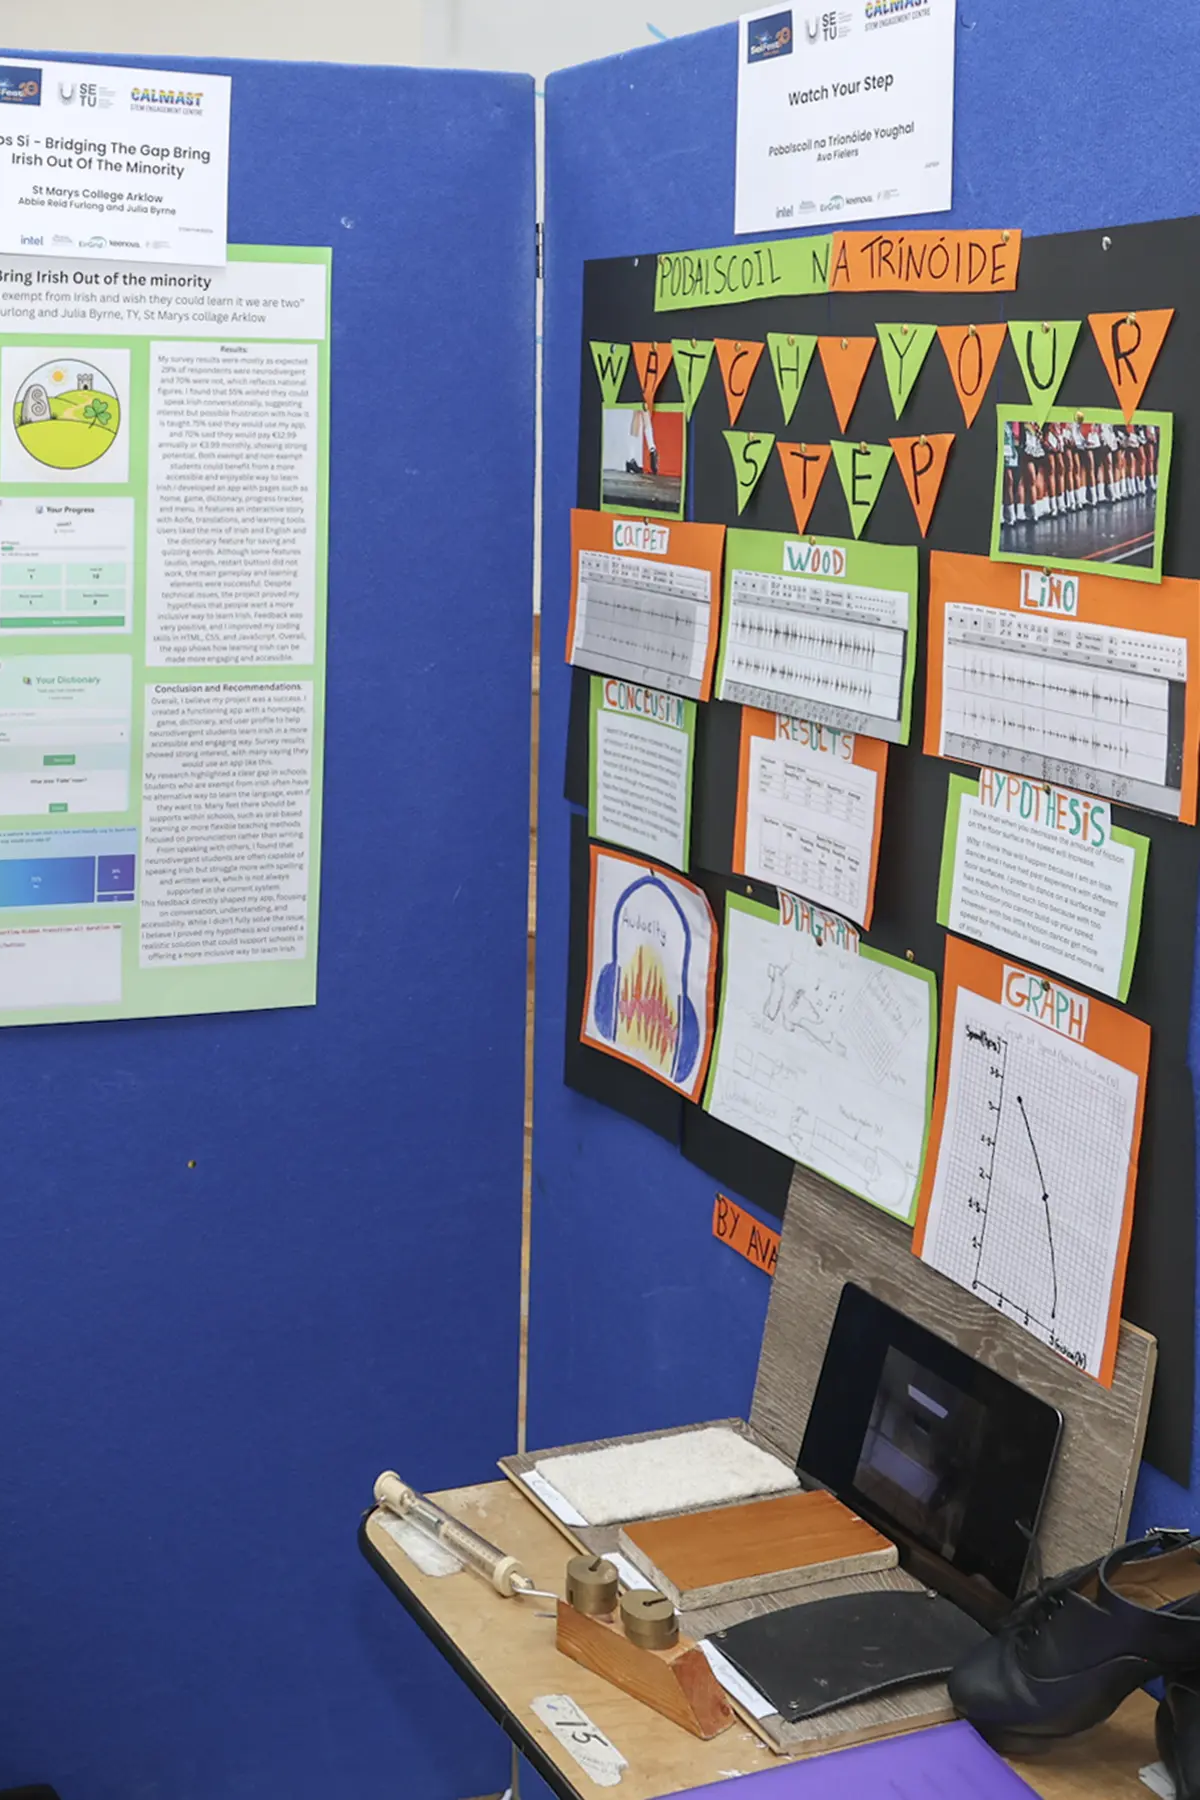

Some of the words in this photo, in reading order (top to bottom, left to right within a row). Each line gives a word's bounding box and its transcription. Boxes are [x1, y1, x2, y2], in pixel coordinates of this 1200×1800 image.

[865, 0, 928, 18] CALMA
[822, 11, 837, 27] SE
[823, 27, 837, 42] TU
[79, 83, 97, 95] SE
[130, 86, 205, 108] CALMAST
[788, 85, 828, 105] Watch
[832, 81, 860, 96] Your
[864, 74, 893, 91] Step
[80, 95, 98, 108] TU
[768, 139, 812, 156] Pobalscoil
[814, 139, 826, 148] na
[874, 121, 914, 140] Youghal
[45, 137, 106, 156] Bridging
[110, 142, 136, 155] The
[140, 144, 170, 160] Gap
[173, 146, 210, 163] Bring
[816, 152, 832, 161] Ava
[12, 152, 42, 166] Irish
[46, 155, 72, 168] Out
[76, 157, 92, 169] Of
[96, 158, 122, 171] The
[126, 160, 184, 179] Minority
[32, 185, 42, 194] St
[46, 186, 79, 199] Marys
[82, 189, 124, 202] College
[126, 192, 162, 202] Arklow
[18, 197, 45, 206] Abbie
[47, 198, 67, 208] Reid
[69, 198, 104, 212] Furlong
[106, 201, 124, 212] and
[126, 205, 148, 213] Julia
[150, 205, 176, 215] Byrne
[20, 234, 44, 246] intel
[659, 248, 781, 298] POBALSCOIL
[812, 240, 850, 285] NA
[36, 270, 68, 283] Irish
[72, 271, 99, 284] Out
[103, 272, 119, 284] of
[122, 272, 146, 286] the
[150, 273, 211, 291] minority
[1, 292, 42, 302] exempt
[45, 290, 71, 302] from
[74, 292, 96, 302] Irish
[99, 293, 119, 303] and
[122, 293, 146, 303] wish
[148, 294, 172, 307] they
[174, 295, 204, 305] could
[206, 296, 233, 306] learn
[236, 297, 243, 306] it
[245, 298, 260, 307] we
[280, 298, 304, 308] two"
[37, 308, 58, 317] and
[60, 308, 86, 318] Julia
[89, 308, 123, 321] Byrne,
[144, 309, 154, 320] St
[157, 310, 189, 322] Marys
[191, 311, 228, 324] collage
[230, 312, 266, 322] Arklow
[598, 349, 799, 397] WATCH
[887, 317, 1142, 396] YOUR
[740, 439, 934, 506] STEP
[64, 506, 94, 514] Progress
[787, 546, 843, 575] WOOD
[35, 676, 55, 684] Your
[57, 675, 100, 685] Dictionary
[154, 684, 202, 693] Conclusion
[204, 684, 220, 692] and
[1005, 973, 1085, 1042] GRAPH
[717, 1197, 740, 1239] BY
